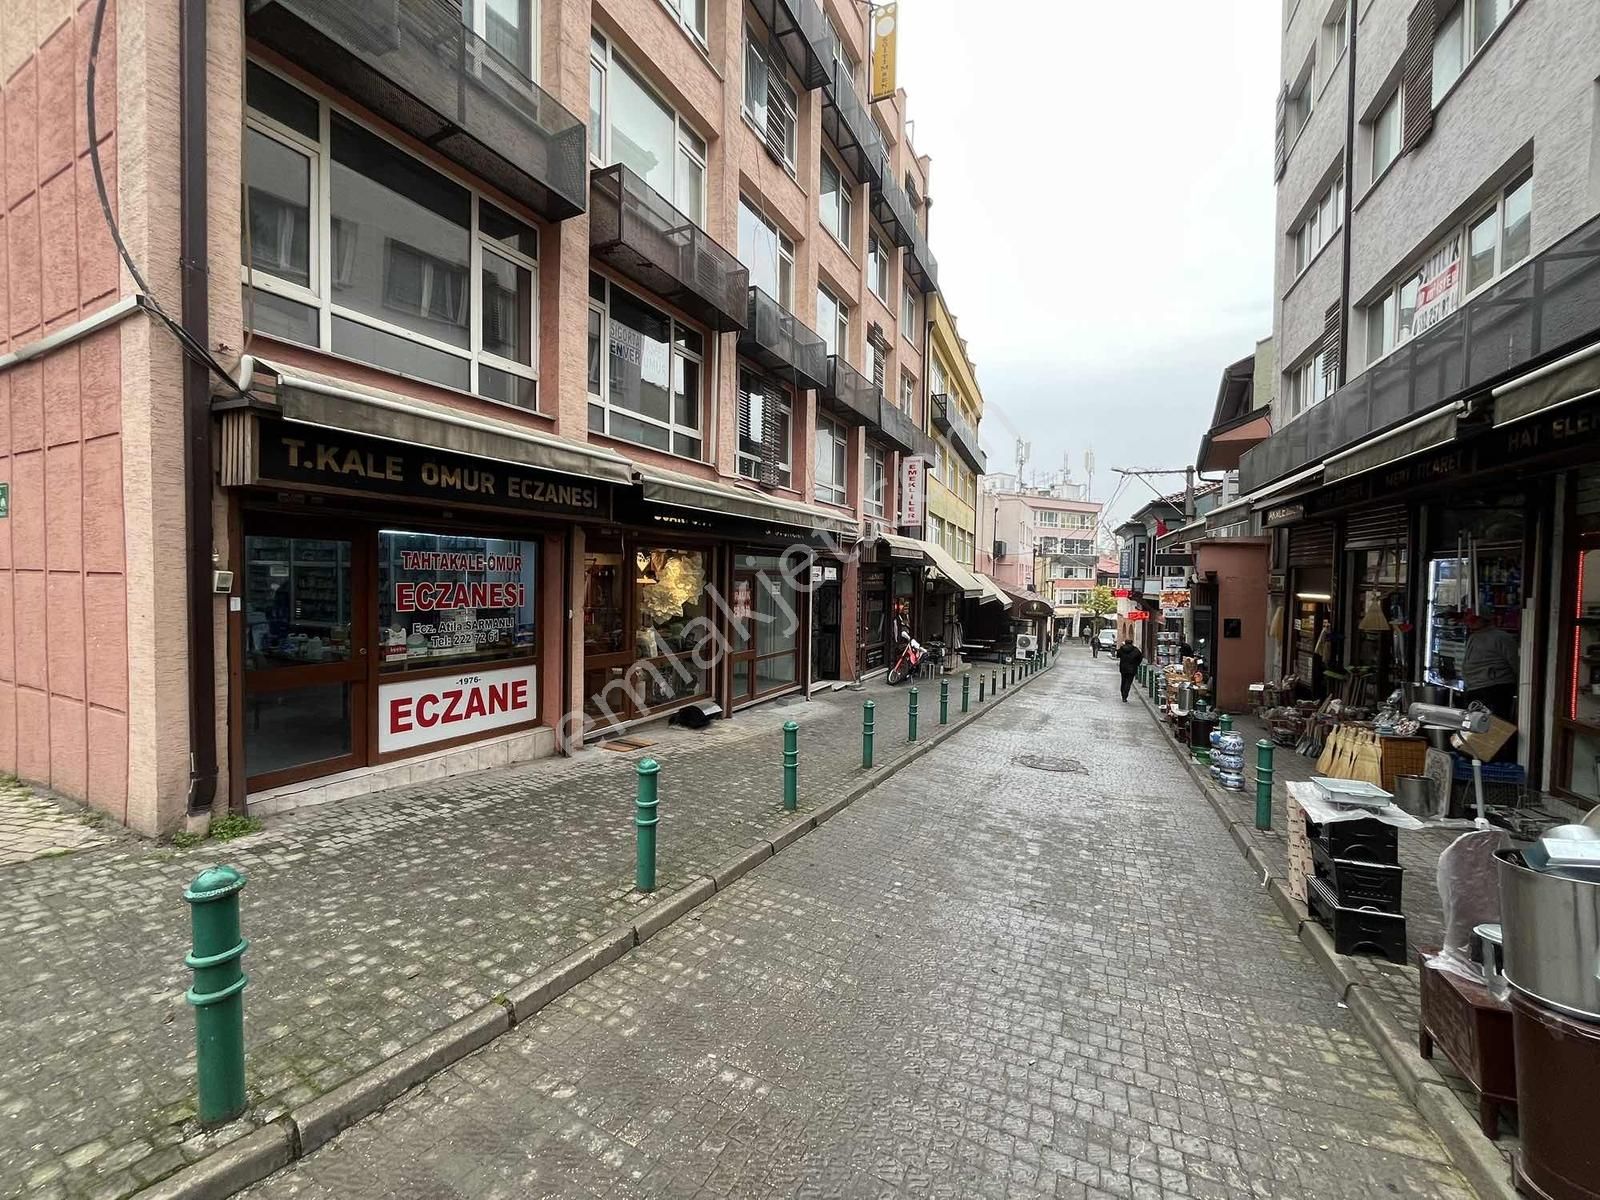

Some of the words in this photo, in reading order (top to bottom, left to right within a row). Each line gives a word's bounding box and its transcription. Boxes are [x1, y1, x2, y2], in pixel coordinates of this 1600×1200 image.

[609, 339, 641, 366] ENVER
[281, 437, 404, 482] T.KALE
[907, 463, 918, 519] EMEKLİLER
[412, 622, 437, 634] Ecz.
[437, 620, 463, 632] Atila
[465, 616, 515, 630] SARMANLI
[431, 635, 451, 648] Tel:
[453, 633, 474, 646] 222
[474, 632, 486, 644] 72
[455, 675, 482, 686] -1976-
[389, 679, 529, 735] ECZANE
